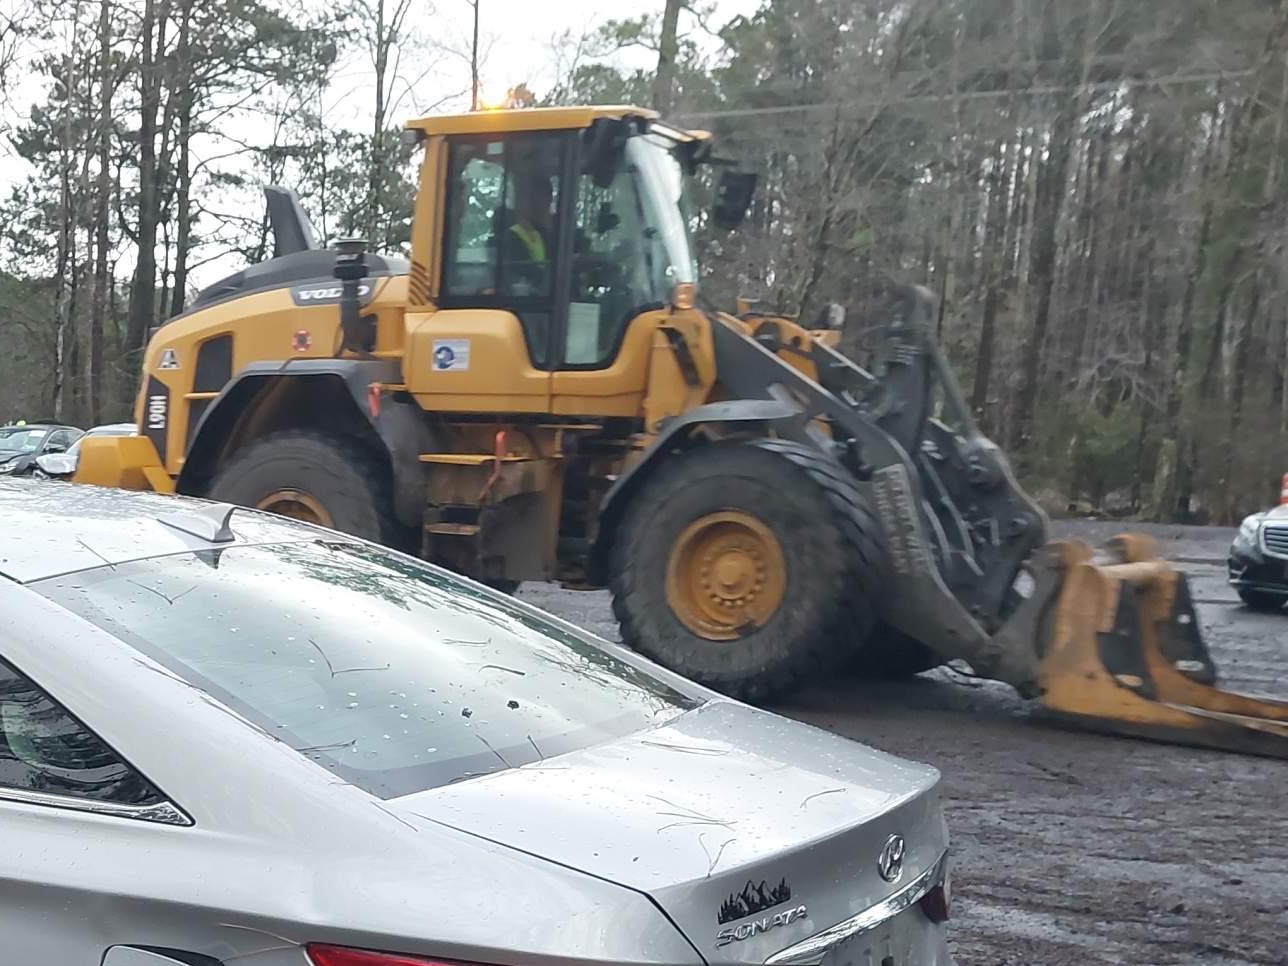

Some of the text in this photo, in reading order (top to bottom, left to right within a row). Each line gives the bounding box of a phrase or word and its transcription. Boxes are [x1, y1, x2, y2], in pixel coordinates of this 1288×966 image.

[298, 284, 370, 300] VOLO
[148, 395, 167, 429] L90H
[716, 903, 808, 951] SONATA
